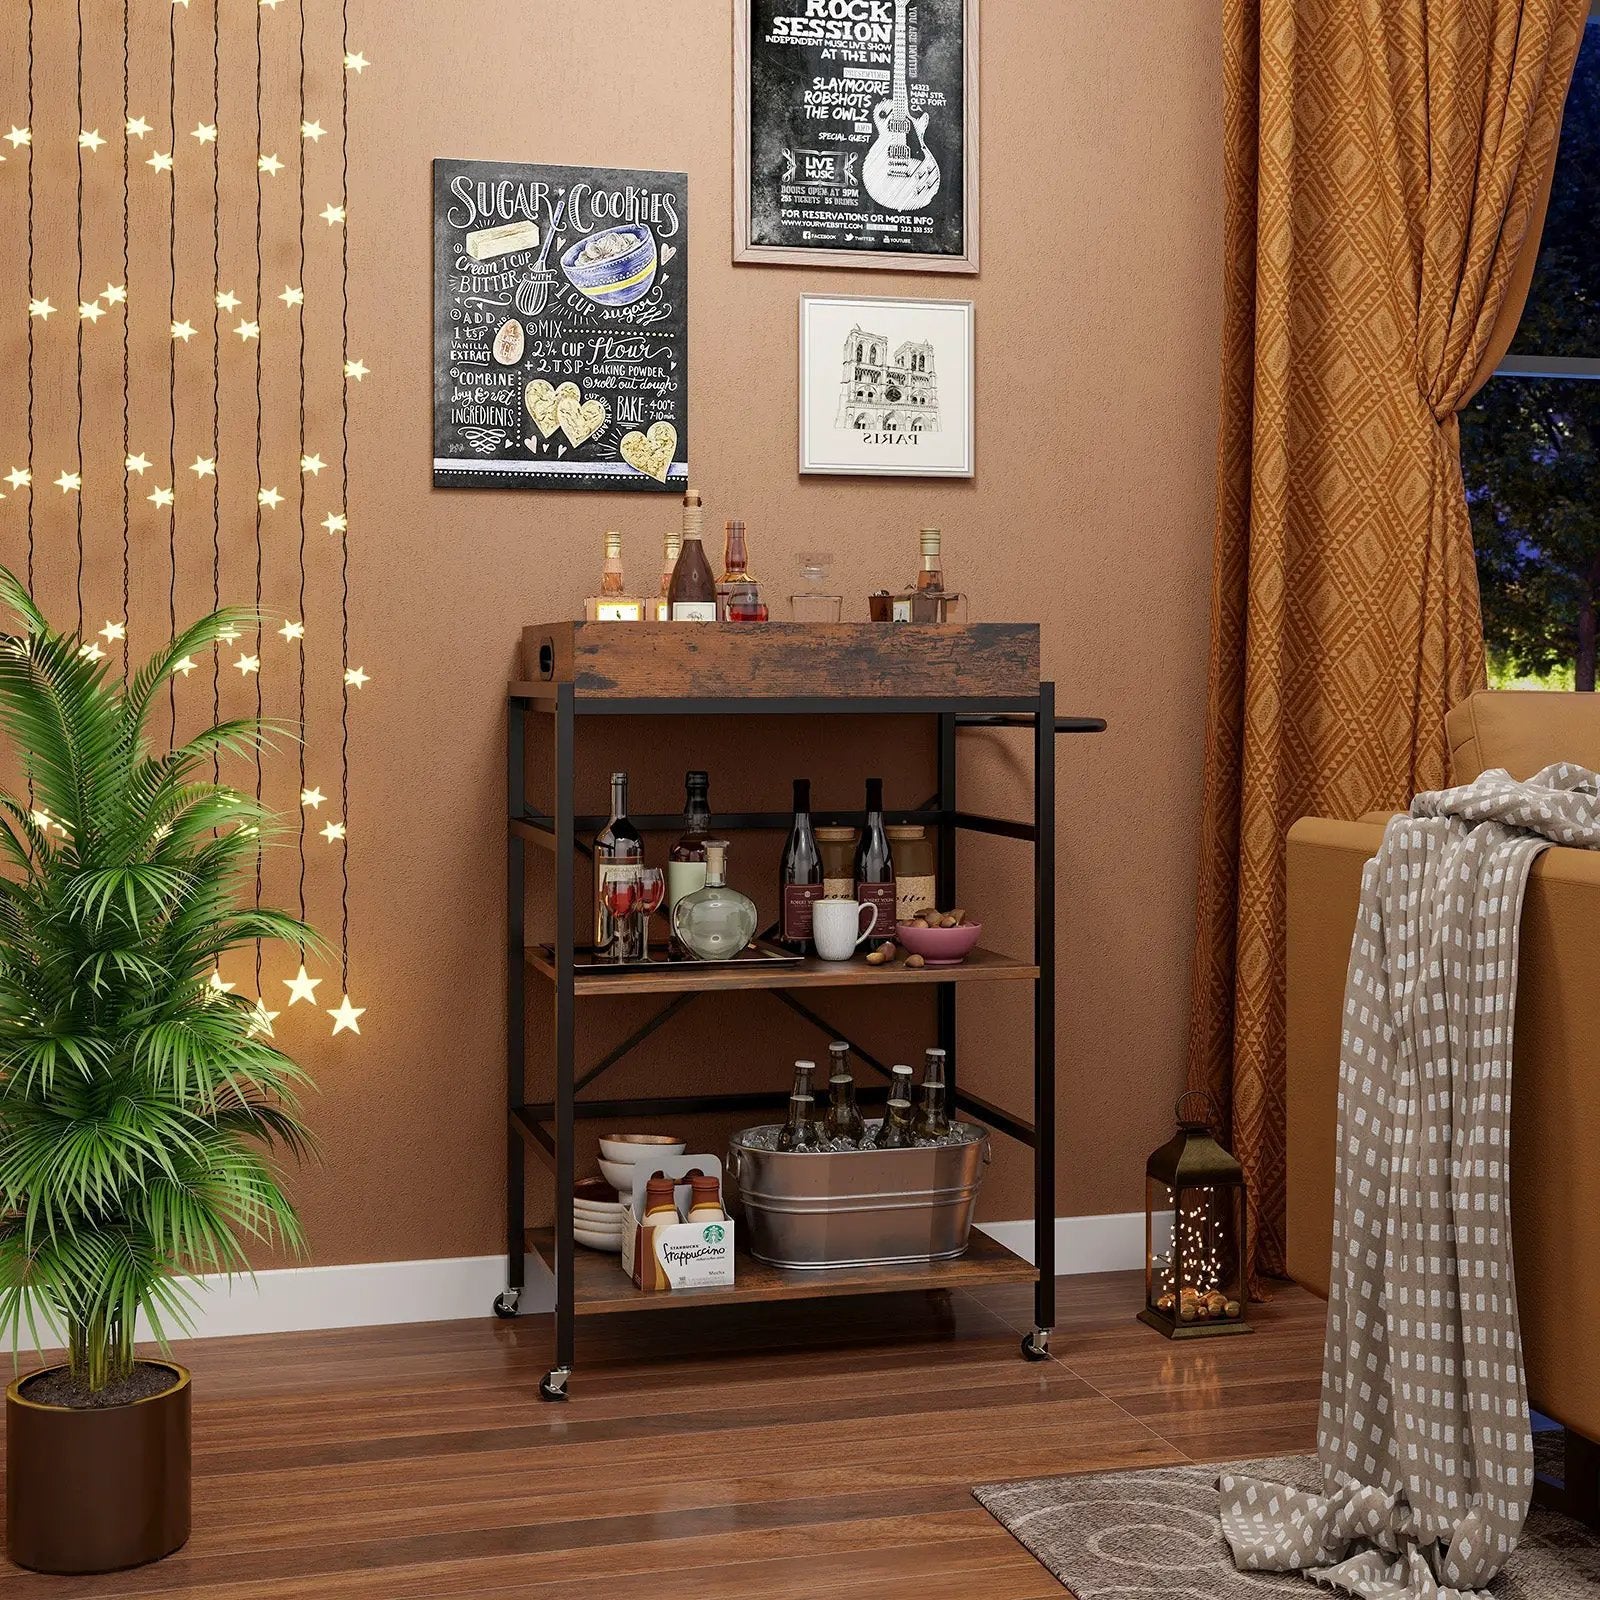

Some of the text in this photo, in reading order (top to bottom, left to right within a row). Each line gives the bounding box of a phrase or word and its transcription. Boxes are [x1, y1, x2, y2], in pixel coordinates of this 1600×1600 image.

[804, 0, 893, 23] ROCK
[772, 16, 893, 43] SESSION
[765, 34, 892, 52] INDEPENDENT MUSIC LIVE SHOW
[908, 6, 918, 79] YOU ARE INVITED
[820, 48, 891, 64] AT THE INN
[812, 76, 890, 95] SLAYMOORE
[910, 83, 930, 92] 14323
[803, 90, 872, 108] ROBSHOTS
[910, 91, 928, 99] MAIN
[910, 98, 947, 107] OLD FORT
[803, 104, 869, 121] THE OWLZ
[910, 104, 923, 112] CA
[818, 132, 871, 143] SPECIAL GUEST
[805, 156, 835, 171] LIVE
[805, 169, 835, 180] MUSIC
[780, 184, 859, 198] DOORS OPEN AT 9PM
[447, 175, 679, 238] SUGAR COOKiES
[793, 195, 821, 204] TICKETS
[834, 197, 859, 207] DRINKS
[781, 209, 934, 226] FOR RESERVATIONS OR MORE INFO
[781, 219, 863, 230] WWW.YOURWEBSITE.COM
[900, 225, 912, 233] 222
[923, 226, 934, 234] 555
[455, 251, 531, 276] Cream 1 CUP
[458, 269, 521, 294] BUTTER
[530, 272, 552, 281] WITH
[554, 282, 663, 323] 1 CUP sugar
[463, 312, 496, 325] ADD
[453, 325, 489, 341] 1 tsp
[538, 319, 563, 339] MIX
[450, 340, 490, 351] VANILLA
[561, 341, 585, 357] CUP
[586, 337, 673, 365] flour
[449, 350, 492, 362] EXTRACT
[536, 359, 551, 373] 2
[551, 359, 584, 375] TSP
[592, 364, 626, 376] BAKING
[628, 365, 668, 378] POWDER
[459, 371, 515, 387] COMBINE
[592, 376, 618, 389] roll
[618, 377, 645, 390] out
[639, 377, 678, 398] dough
[450, 386, 516, 408] dry & wet
[451, 405, 514, 427] INGREDIENTS
[584, 393, 613, 442] CUT OUT HEARTS
[662, 1242, 726, 1267] frappuccino
[669, 1243, 699, 1251] STARBUCKS
